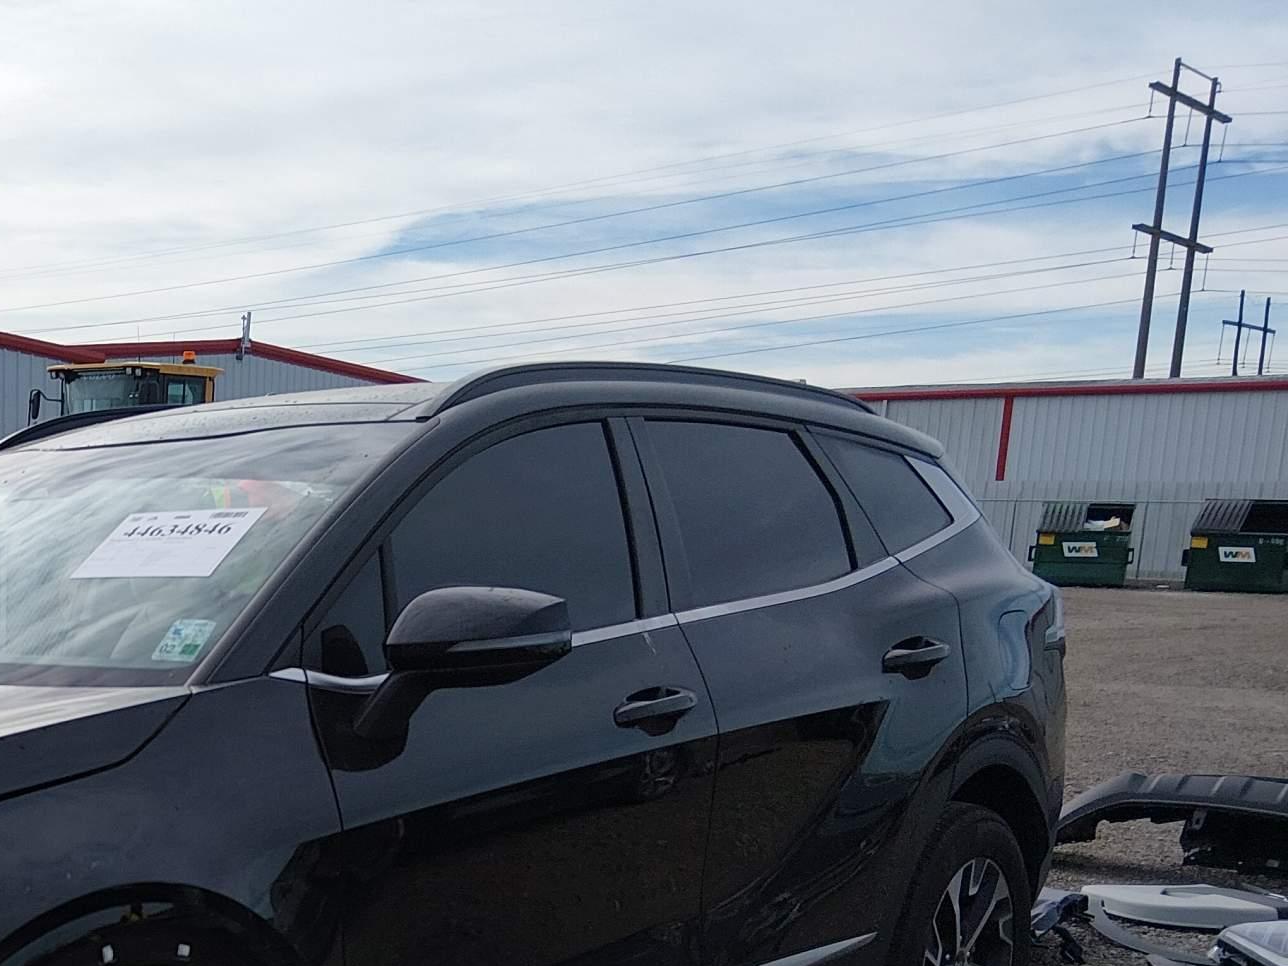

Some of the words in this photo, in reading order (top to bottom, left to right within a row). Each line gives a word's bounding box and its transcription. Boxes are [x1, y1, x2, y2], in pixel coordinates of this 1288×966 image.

[123, 522, 234, 537] 44634846
[1068, 545, 1096, 554] WM
[1223, 550, 1251, 560] WM
